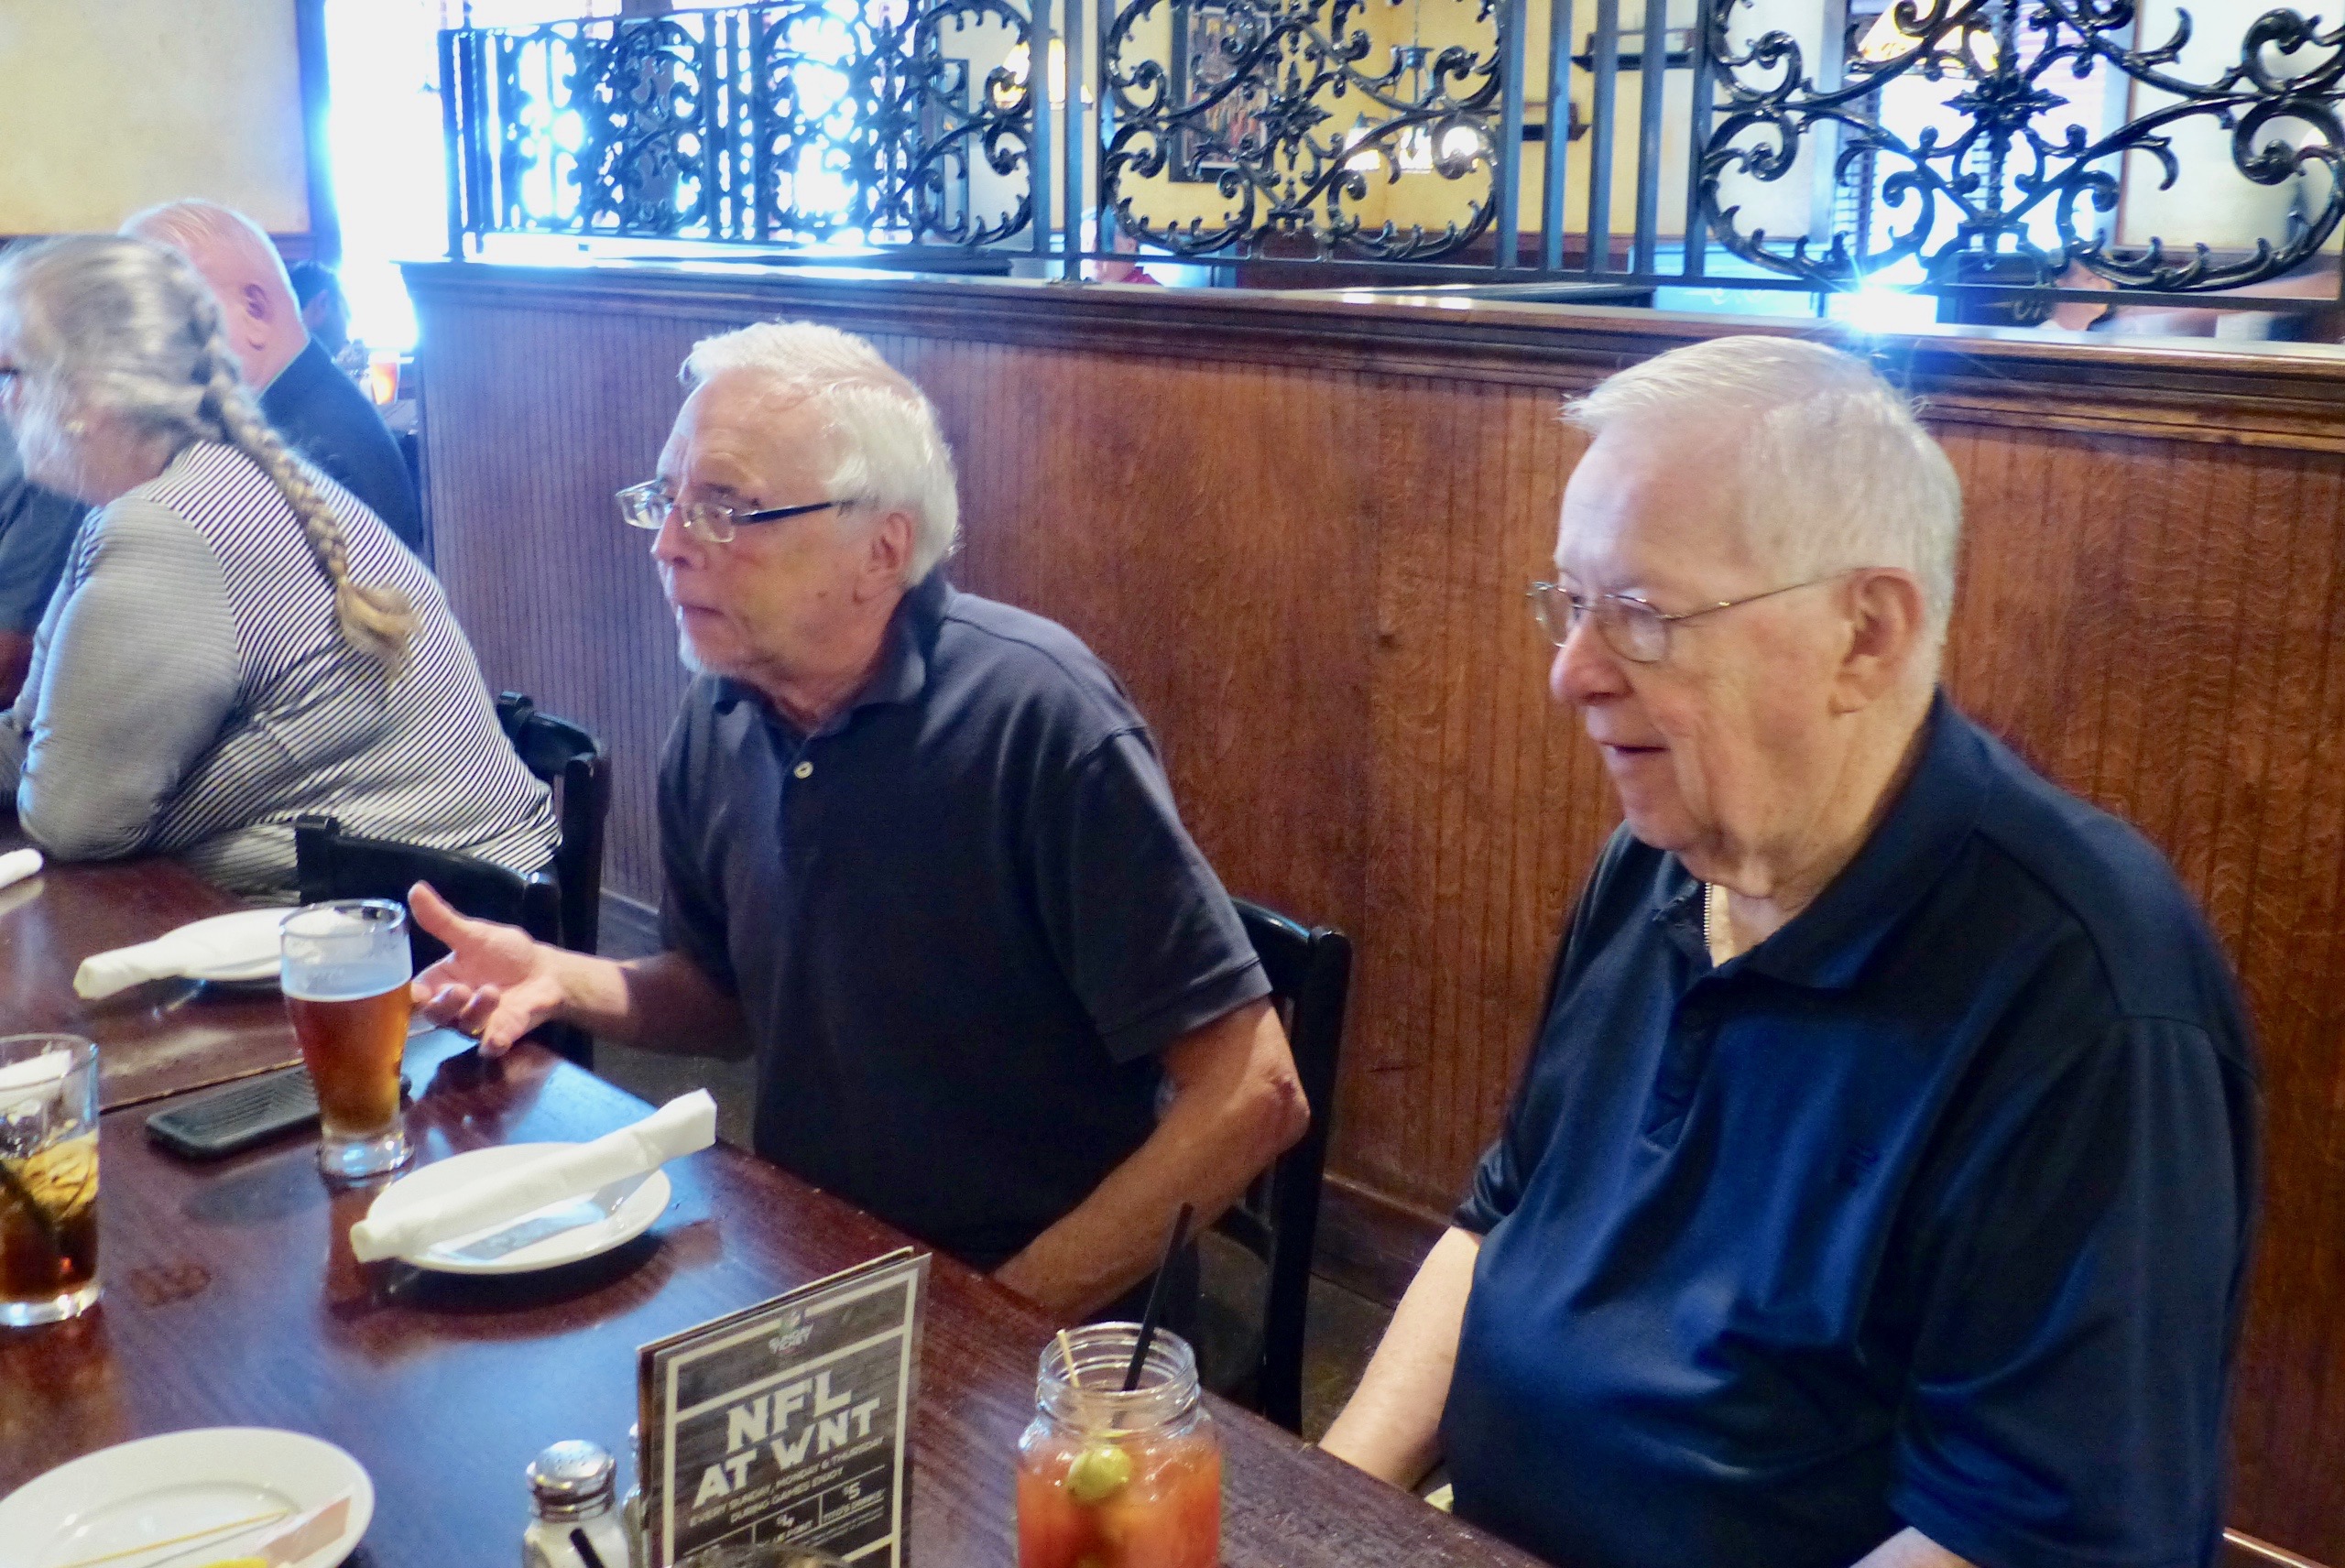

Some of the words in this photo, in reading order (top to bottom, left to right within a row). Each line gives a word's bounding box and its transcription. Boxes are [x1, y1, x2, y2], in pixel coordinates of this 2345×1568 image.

[692, 1450, 758, 1509] AT
[770, 1398, 881, 1470] WNT
[725, 1370, 852, 1454] NFL
